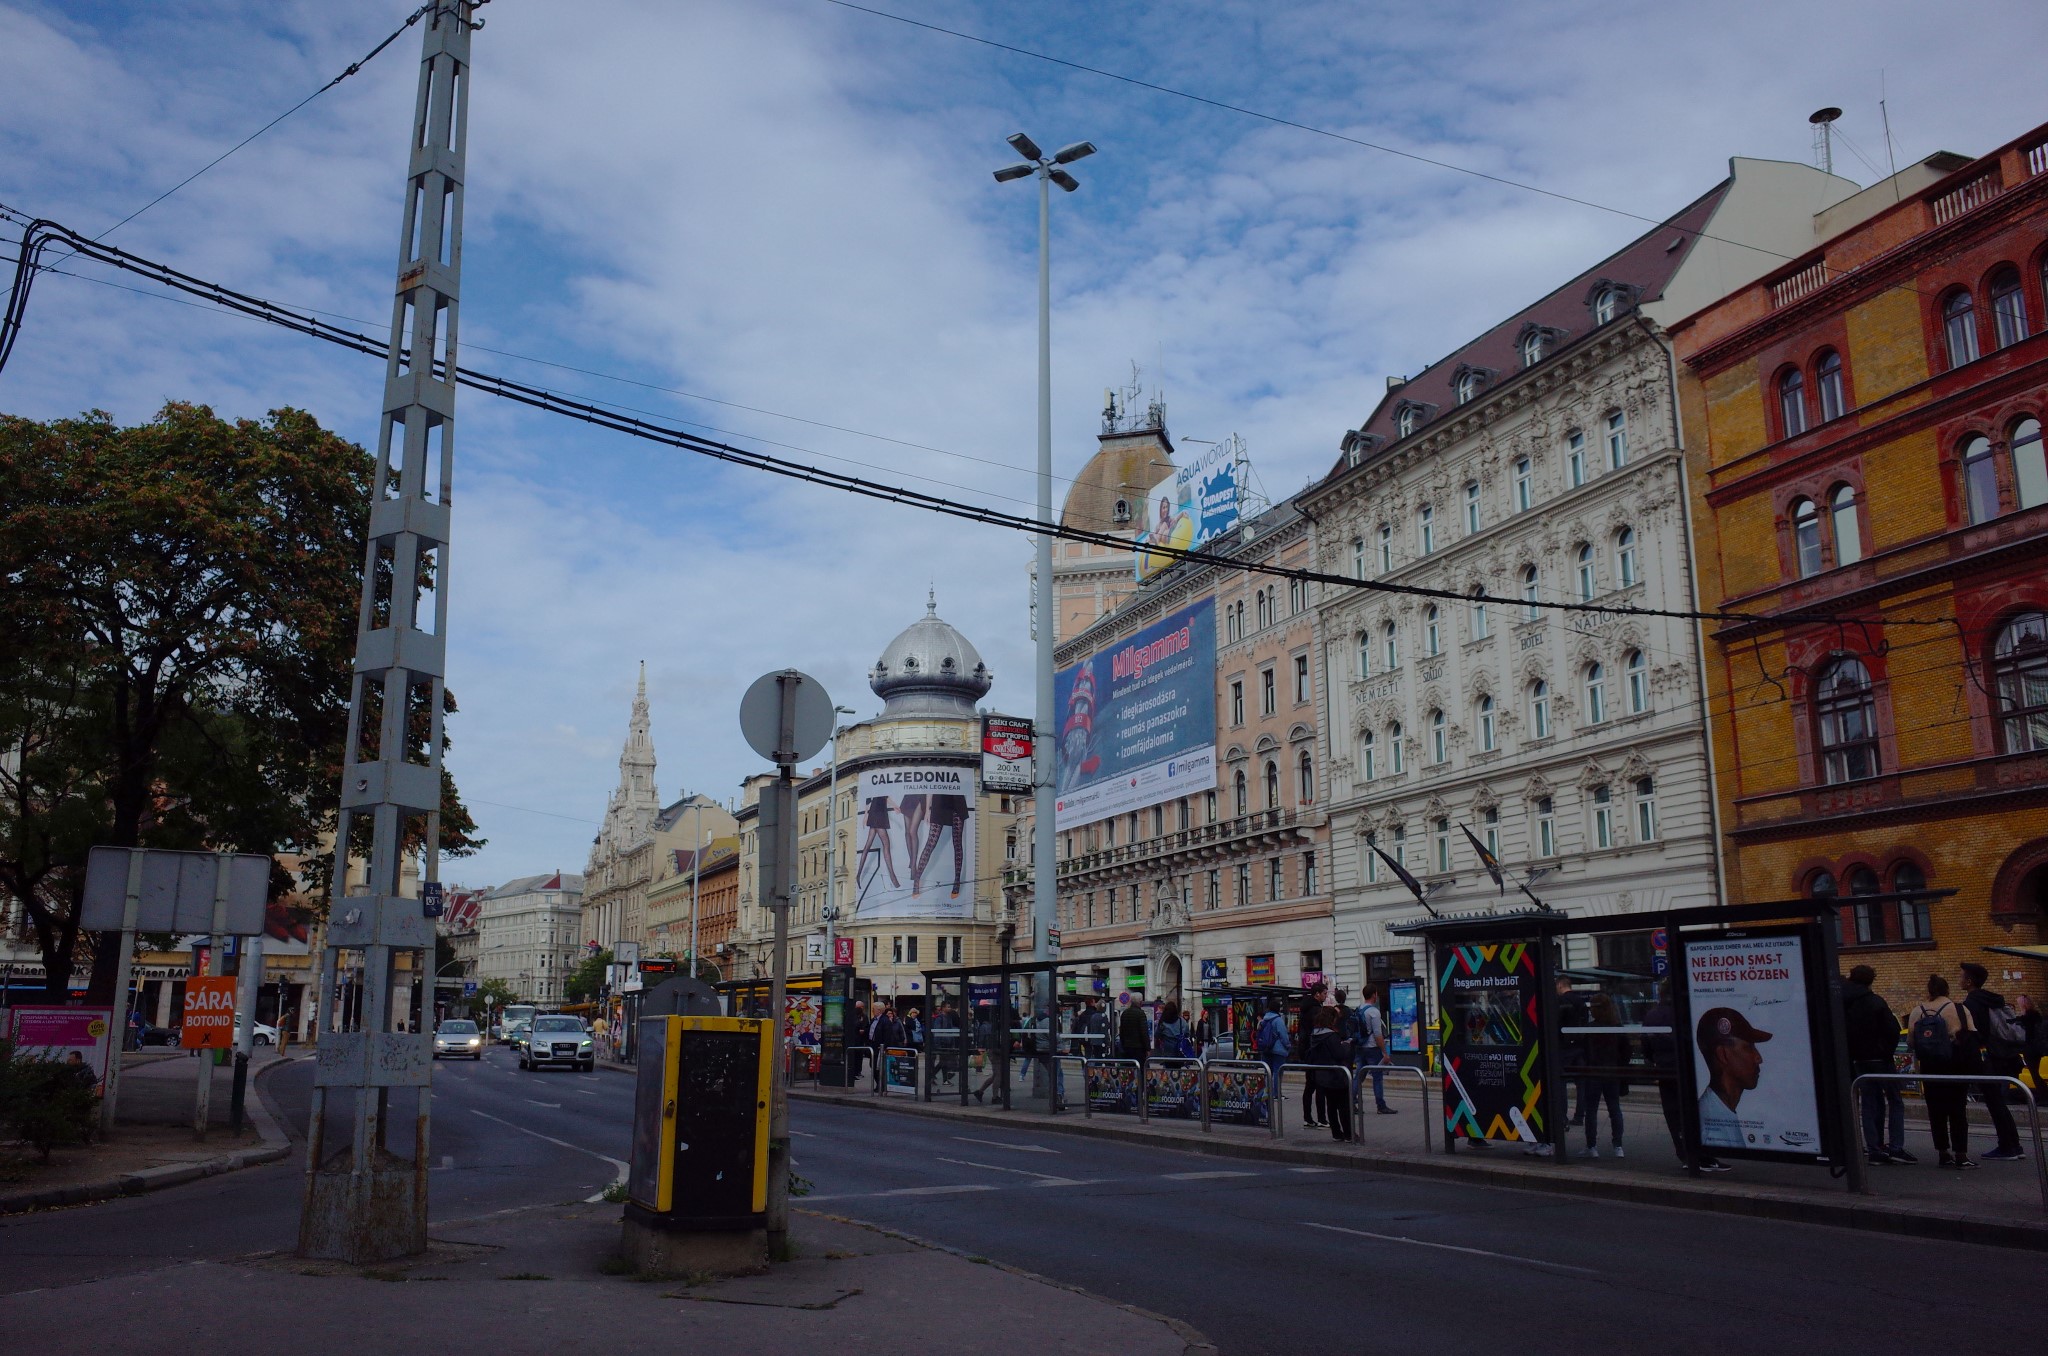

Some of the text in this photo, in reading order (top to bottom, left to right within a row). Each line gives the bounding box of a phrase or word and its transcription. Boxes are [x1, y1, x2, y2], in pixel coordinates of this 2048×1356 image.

[1176, 438, 1232, 488] AQUAWORLD
[1203, 487, 1235, 508] BUDAPEST
[1112, 685, 1132, 700] Mindent
[1132, 681, 1141, 693] tud
[1147, 671, 1164, 685] idegek
[1355, 682, 1398, 705] NEMZETI
[1121, 689, 1176, 721] idegkárosodásra
[1008, 720, 1030, 729] CRAFT
[1121, 723, 1146, 739] reumás
[991, 731, 1030, 741] GASTROPUB
[996, 764, 1020, 773] 200 M
[871, 771, 961, 786] CALZEDONIA
[1691, 953, 1783, 968] NE ÍRJON SMS-T
[1657, 962, 1665, 975] P
[1692, 965, 1790, 983] VEZETÉS KÖZBEN
[184, 986, 234, 1011] SÁRA
[186, 1015, 231, 1027] BOTOND
[1791, 1130, 1809, 1138] ACTION
